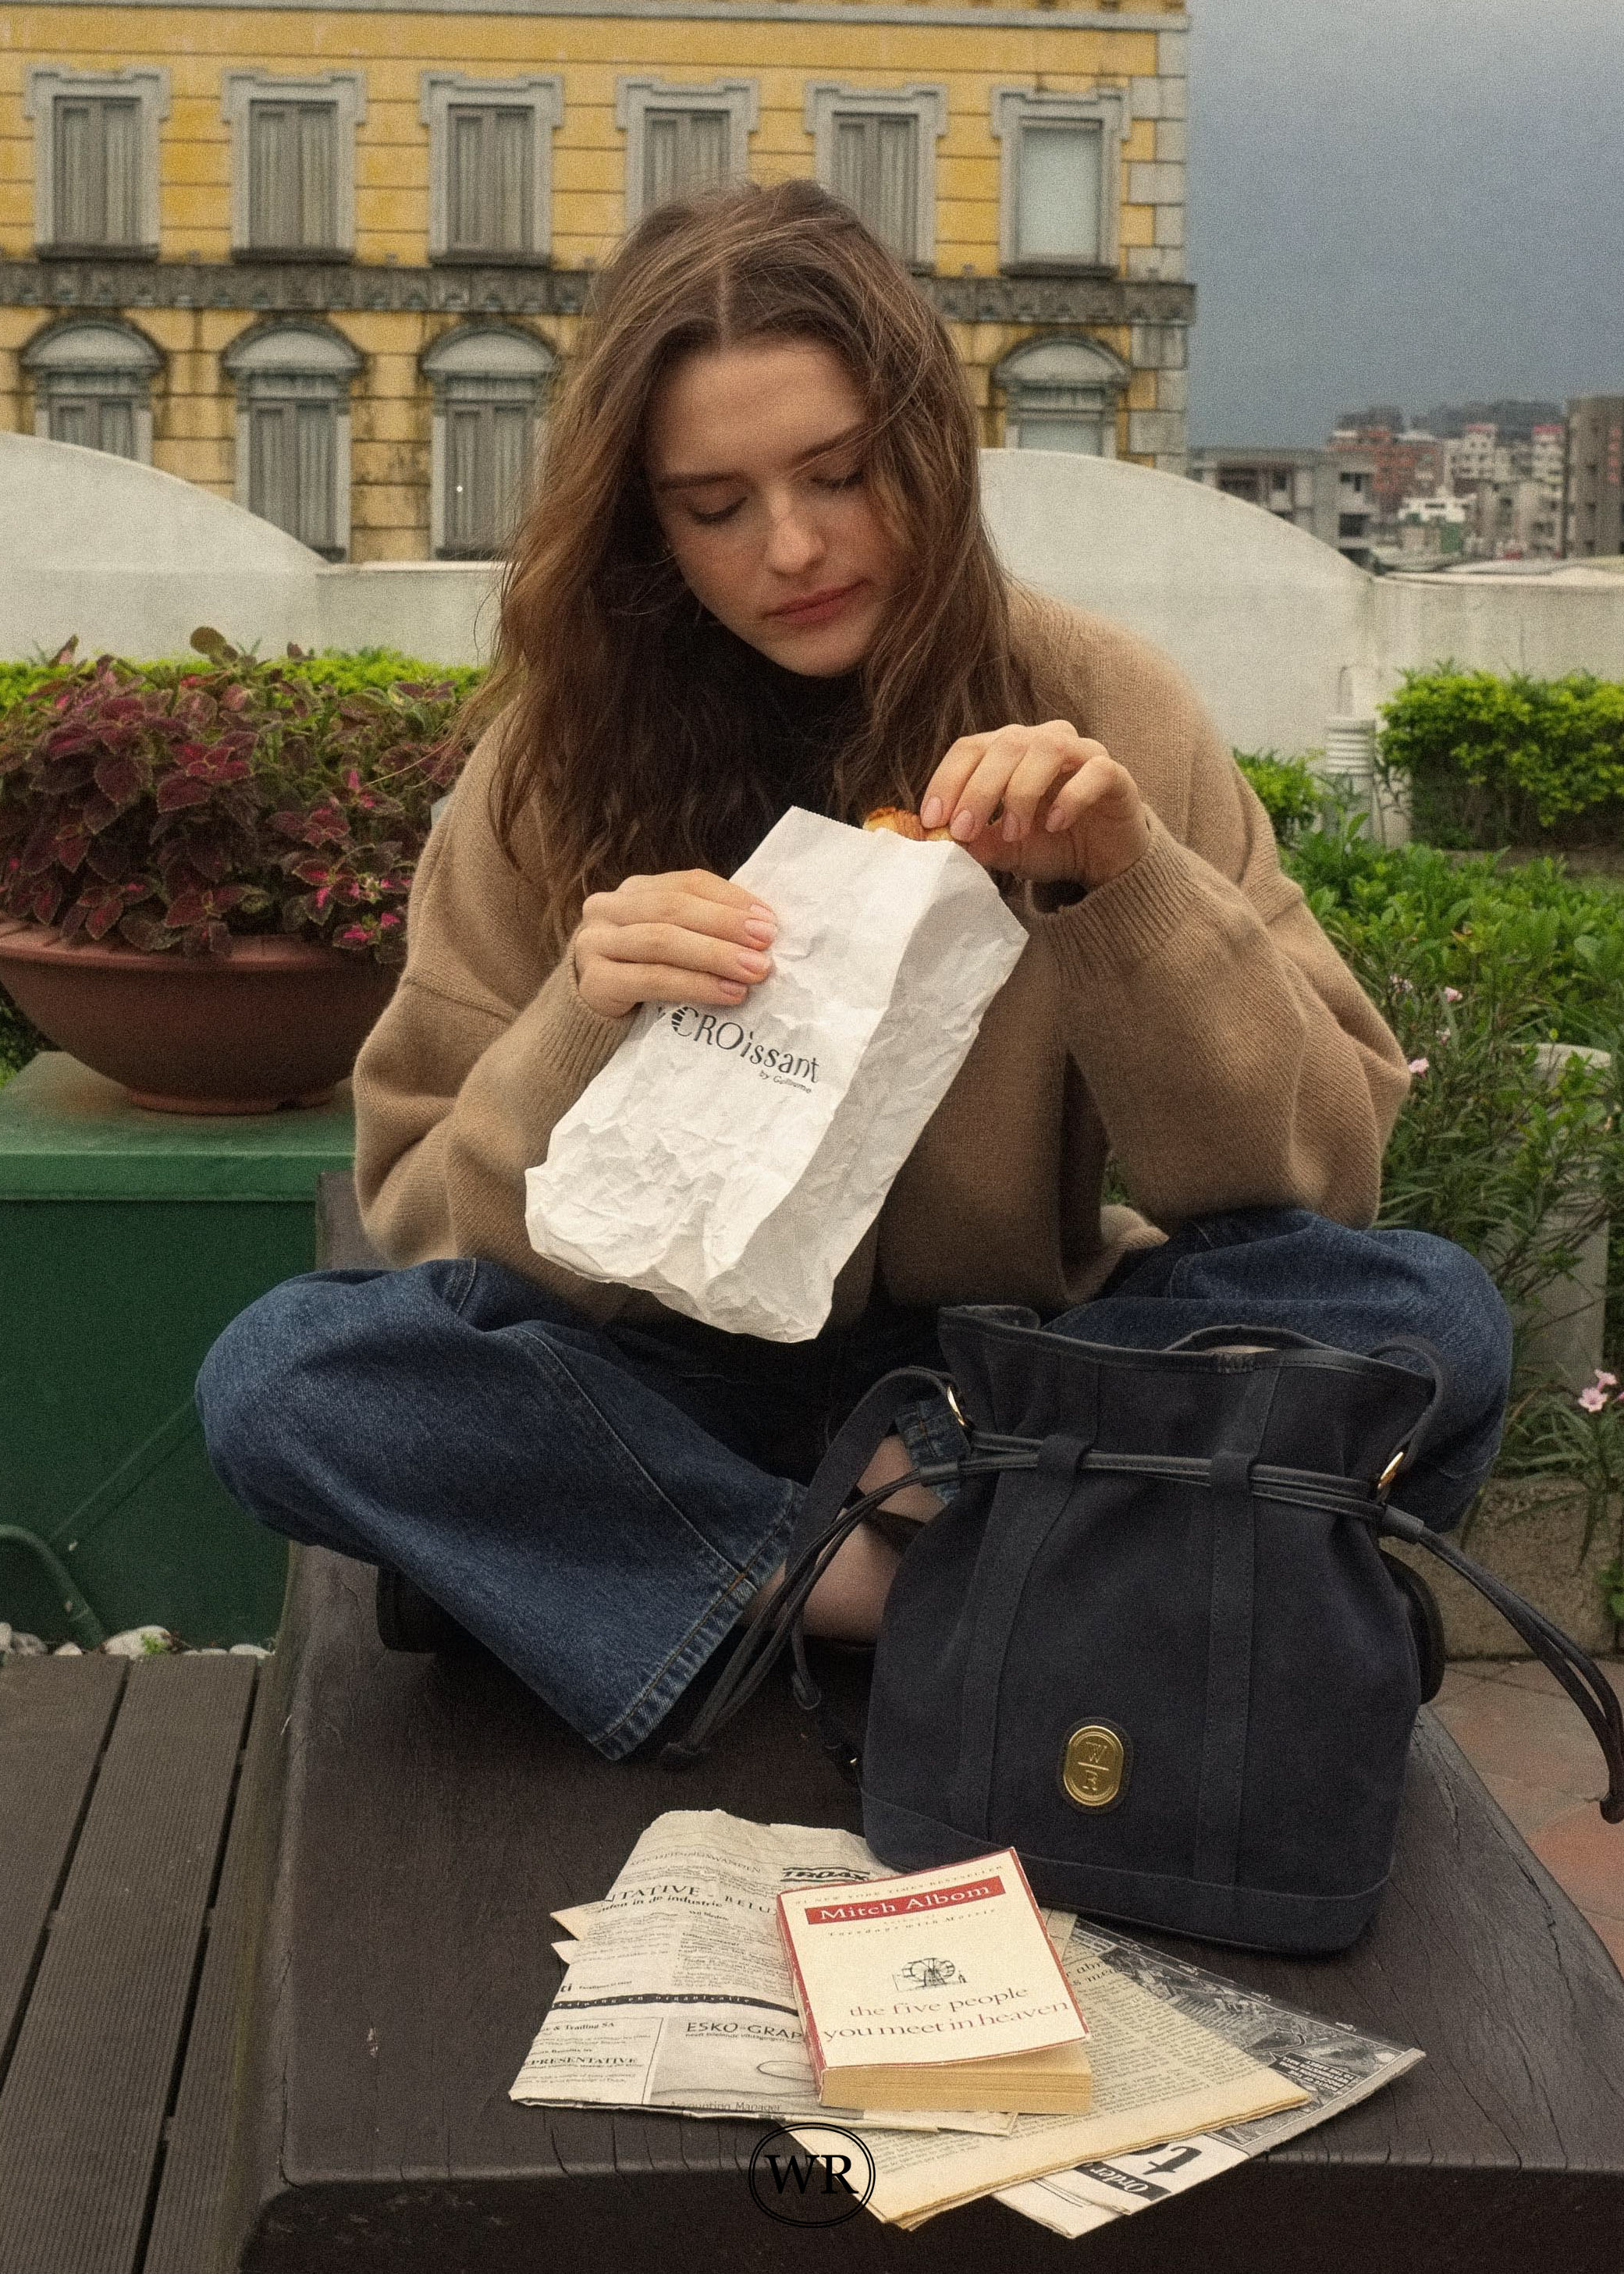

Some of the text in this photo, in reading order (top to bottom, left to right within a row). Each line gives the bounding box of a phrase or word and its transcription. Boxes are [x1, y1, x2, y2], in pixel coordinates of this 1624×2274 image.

[672, 1006, 819, 1083] CROissant
[819, 1887, 990, 1920] Mitch Albom
[849, 1988, 1029, 2016] the five people
[824, 2002, 1069, 2042] you meet in heaven
[1090, 2167, 1150, 2193] Order
